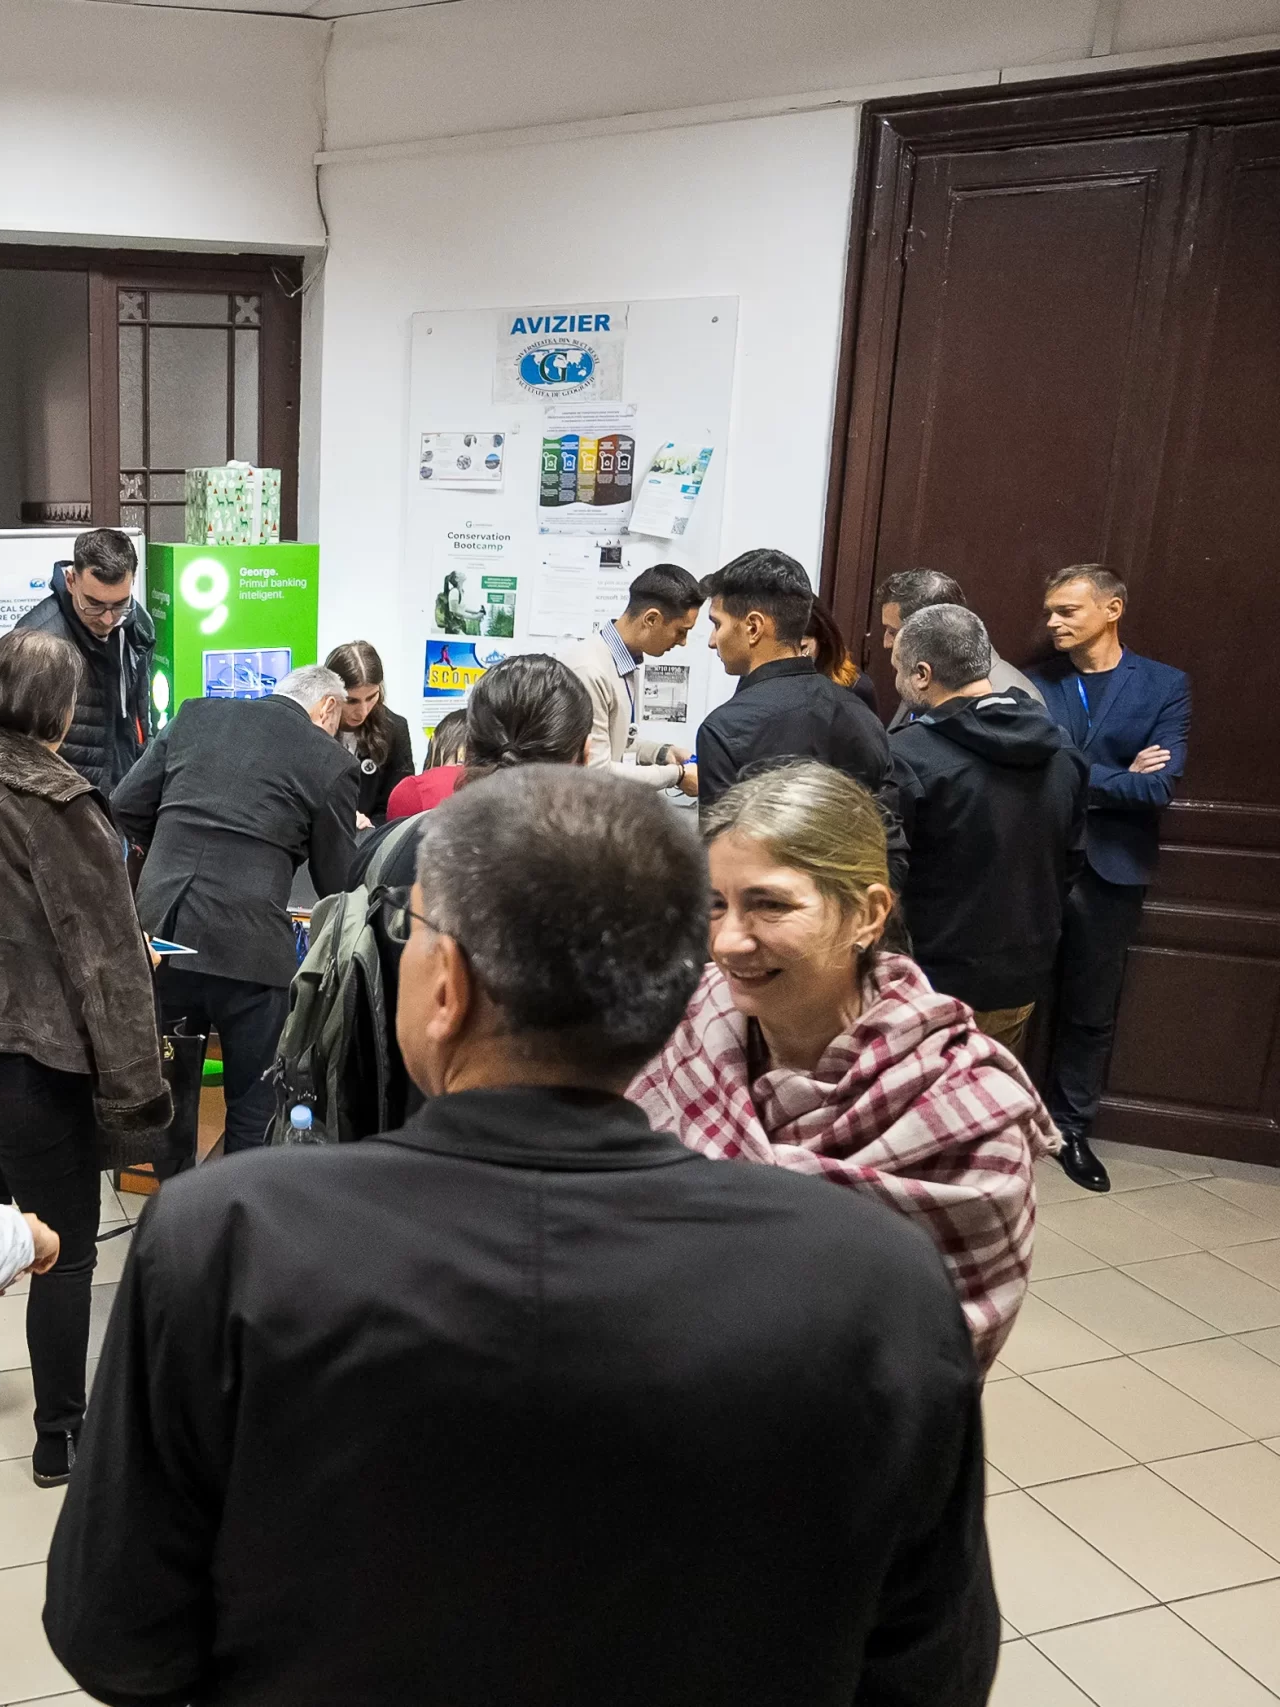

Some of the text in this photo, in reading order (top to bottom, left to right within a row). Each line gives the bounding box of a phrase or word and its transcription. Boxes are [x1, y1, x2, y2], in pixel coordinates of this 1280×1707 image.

[510, 314, 611, 335] AVIZIER
[447, 531, 511, 541] Conservation
[453, 541, 503, 551] Bootcamp
[239, 567, 279, 578] George.
[239, 578, 307, 589] Primul banking
[239, 590, 285, 601] inteligent.
